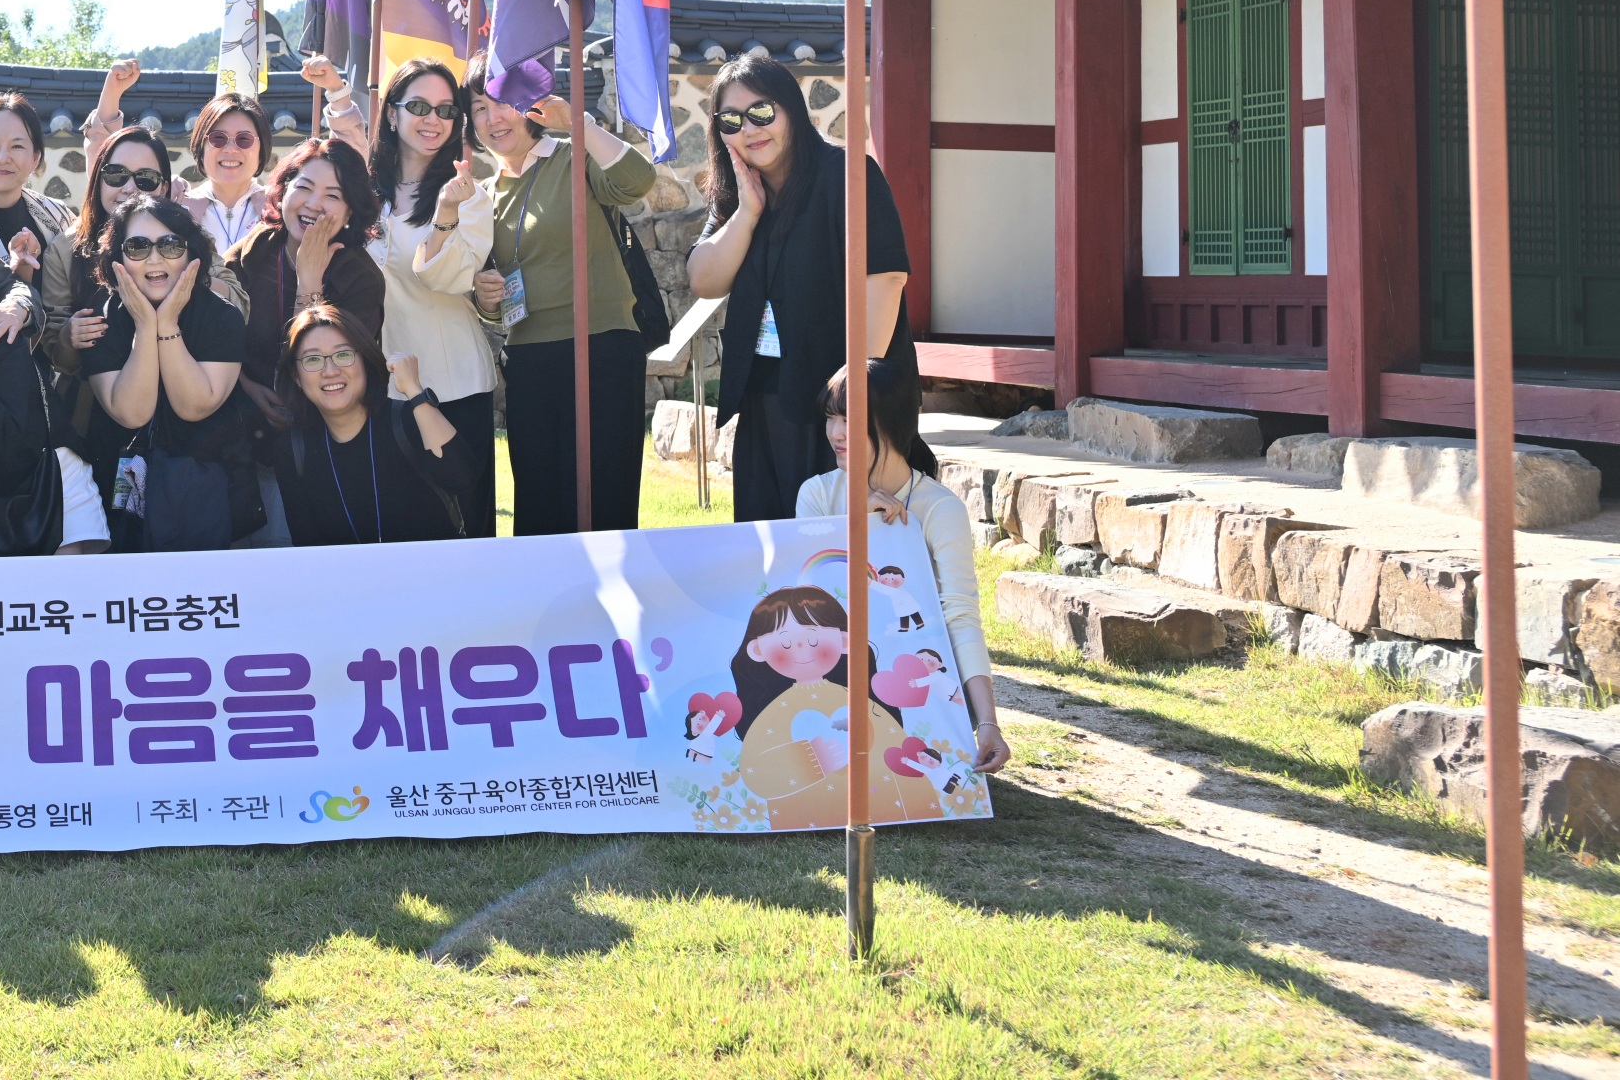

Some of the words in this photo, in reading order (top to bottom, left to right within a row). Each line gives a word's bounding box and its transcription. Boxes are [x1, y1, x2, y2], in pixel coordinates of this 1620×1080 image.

[106, 593, 240, 633] 마음충전
[26, 652, 320, 765] 마음을
[385, 784, 430, 809] 울산
[394, 809, 429, 818] ULSAN
[432, 806, 476, 817] JUNGGU
[478, 804, 527, 814] SUPPORT
[530, 801, 573, 812] CENTER
[575, 800, 597, 809] FOR
[599, 795, 660, 808] CHILDCARE
[45, 802, 93, 827] 일대
